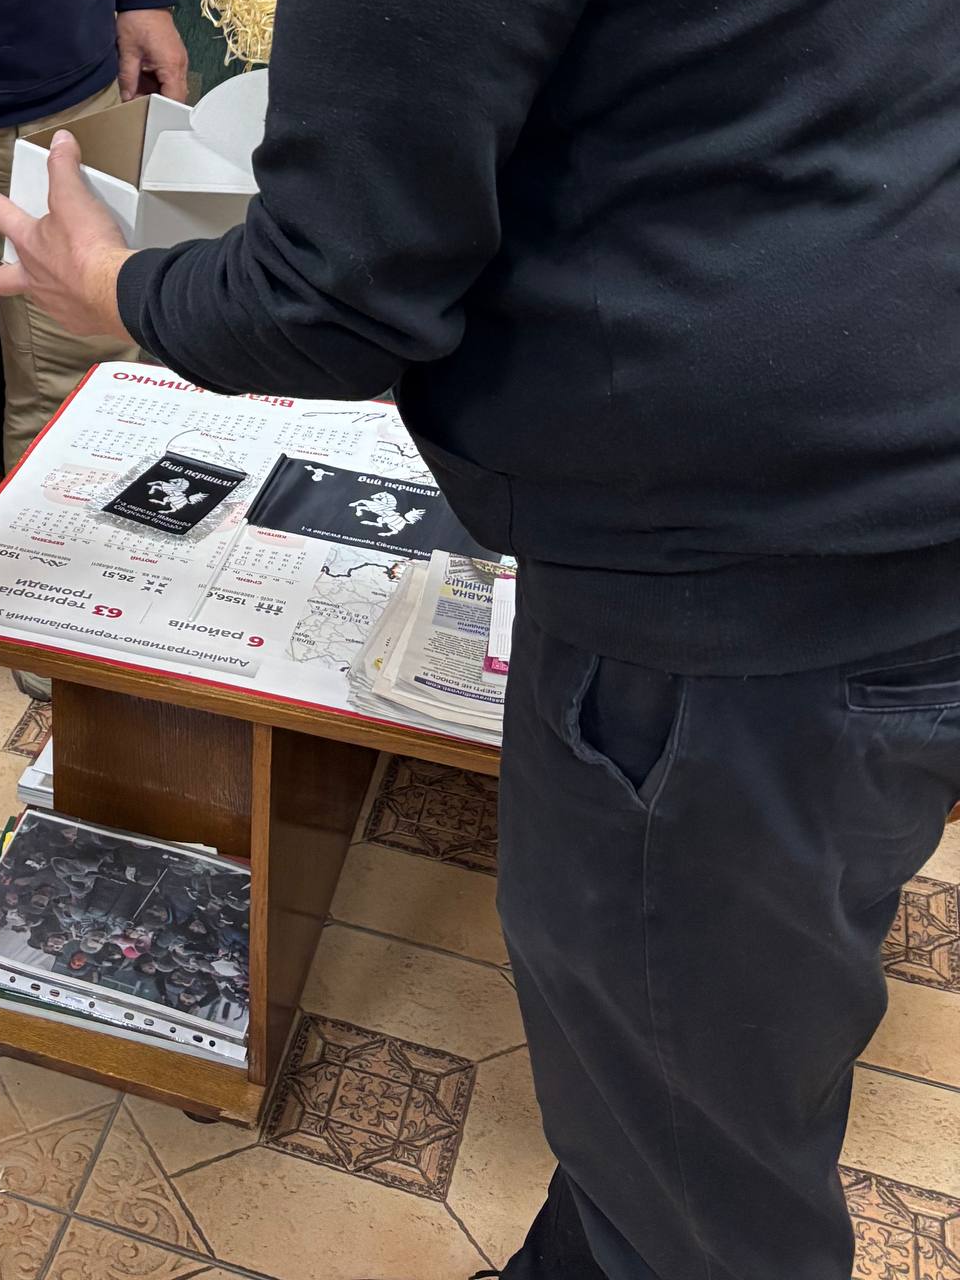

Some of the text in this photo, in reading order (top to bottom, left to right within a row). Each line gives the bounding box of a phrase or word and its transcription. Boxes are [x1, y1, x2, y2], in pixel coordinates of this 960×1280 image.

[384, 481, 441, 497] першим!
[102, 570, 135, 583] 26,51
[15, 578, 93, 600] громади
[444, 577, 493, 594] ІННИЦІ?
[451, 588, 493, 604] ЖАВНА
[92, 605, 124, 619] 63
[6, 611, 250, 668] Адміністративно-територіальний
[168, 619, 265, 648] 6 районів
